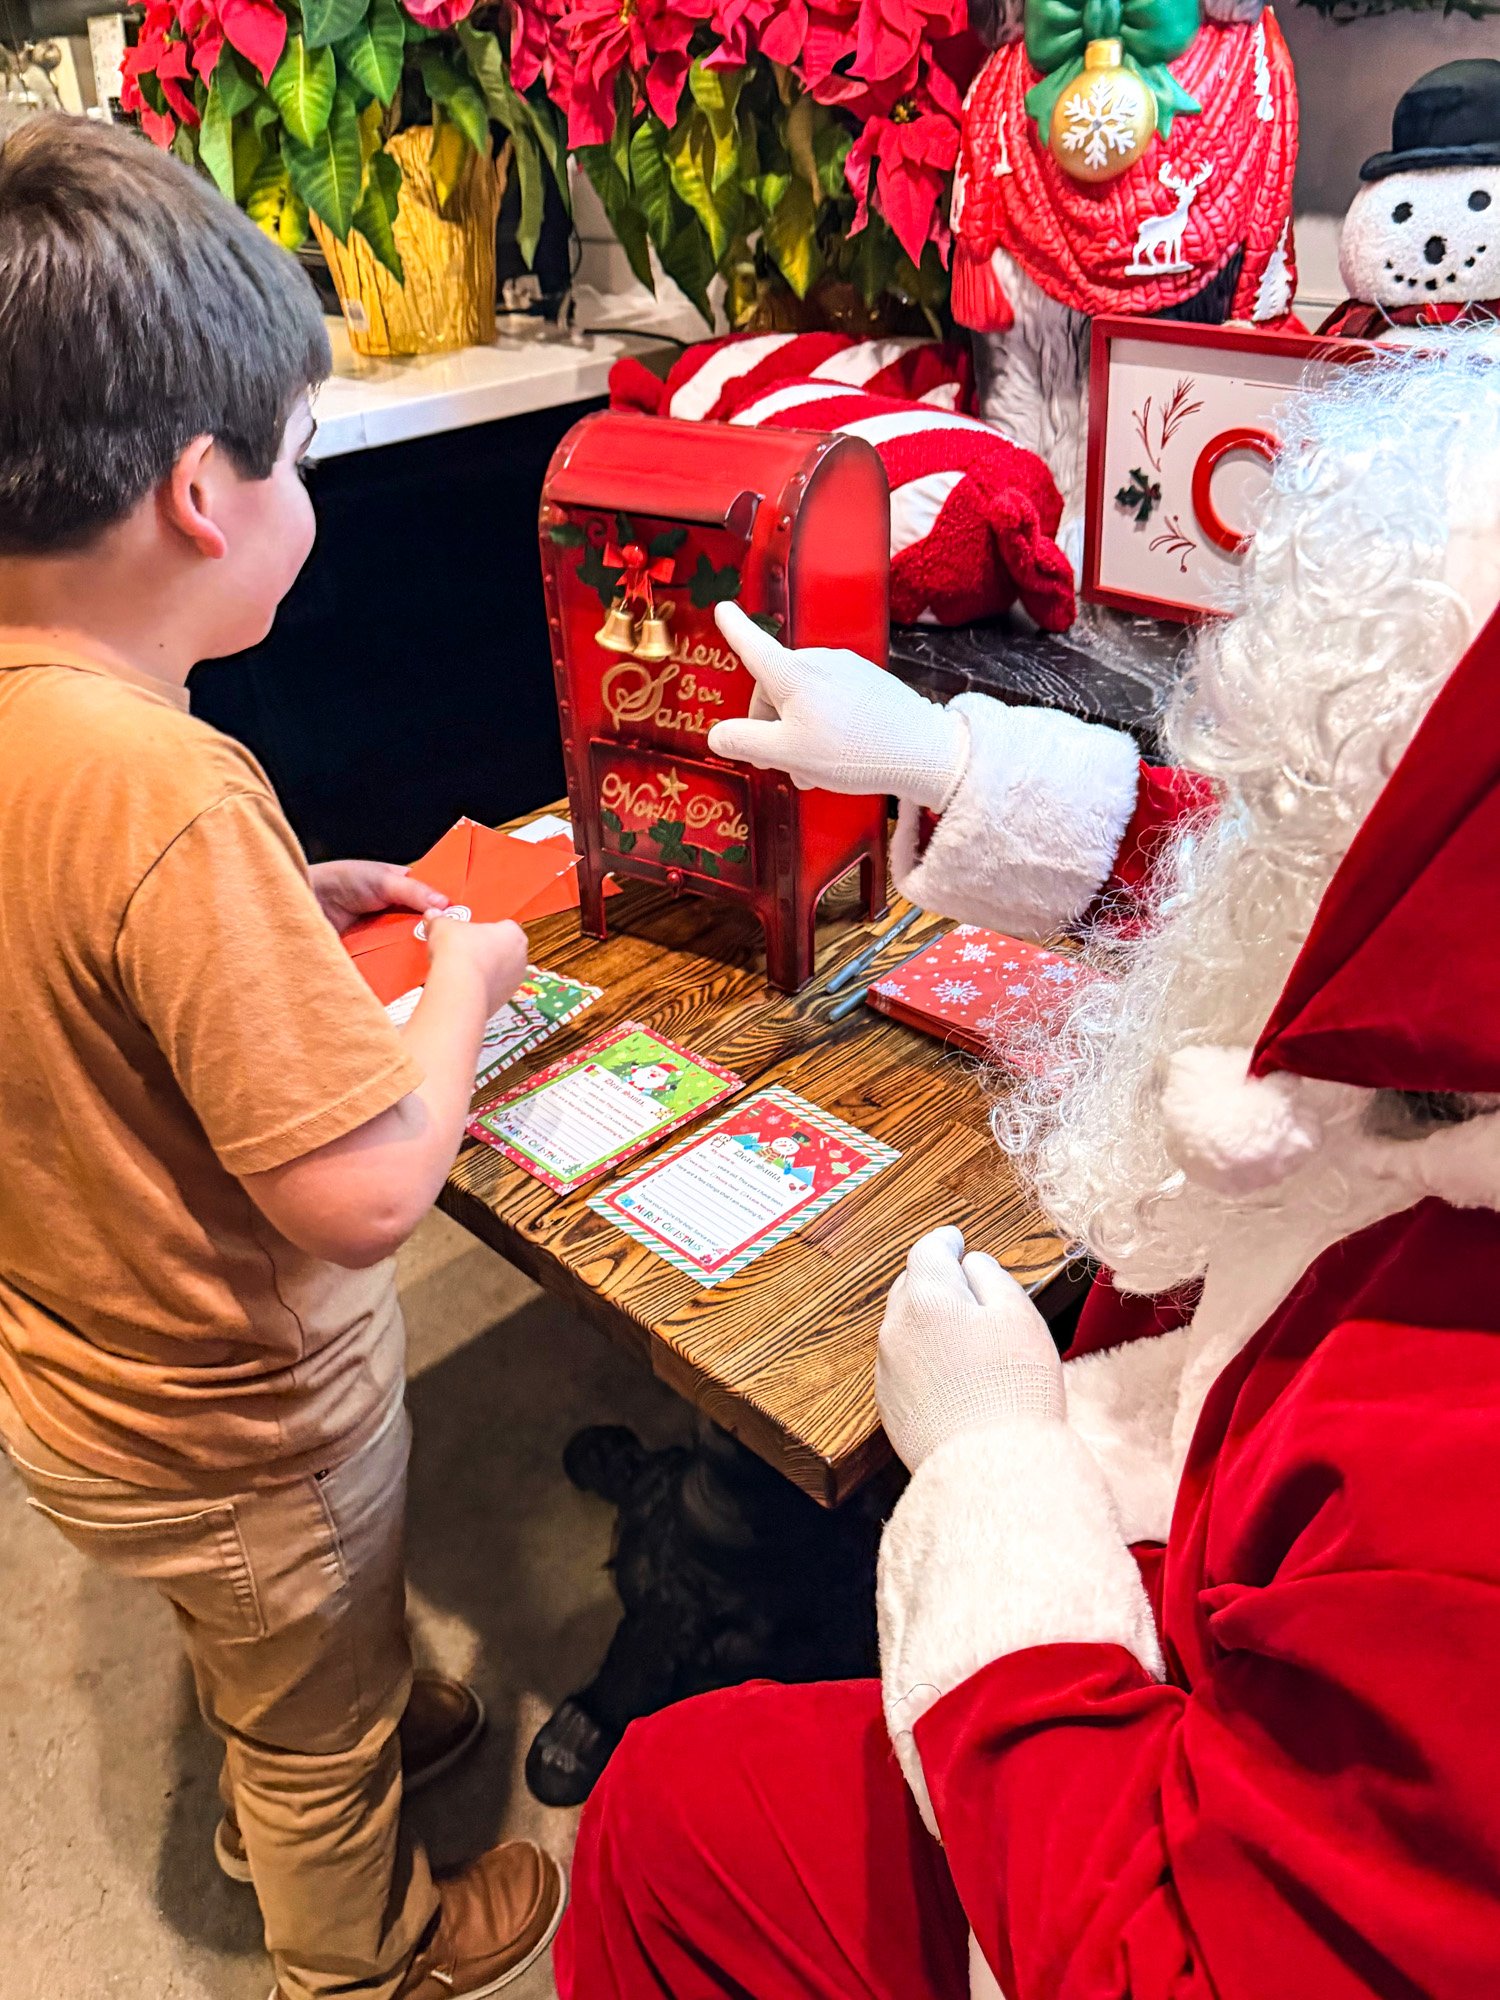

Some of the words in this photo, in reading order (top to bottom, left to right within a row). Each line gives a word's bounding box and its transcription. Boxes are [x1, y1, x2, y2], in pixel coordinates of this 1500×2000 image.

[602, 662, 720, 734] Sant
[677, 674, 724, 705] For
[600, 772, 679, 822] North
[733, 1149, 754, 1164] Dear
